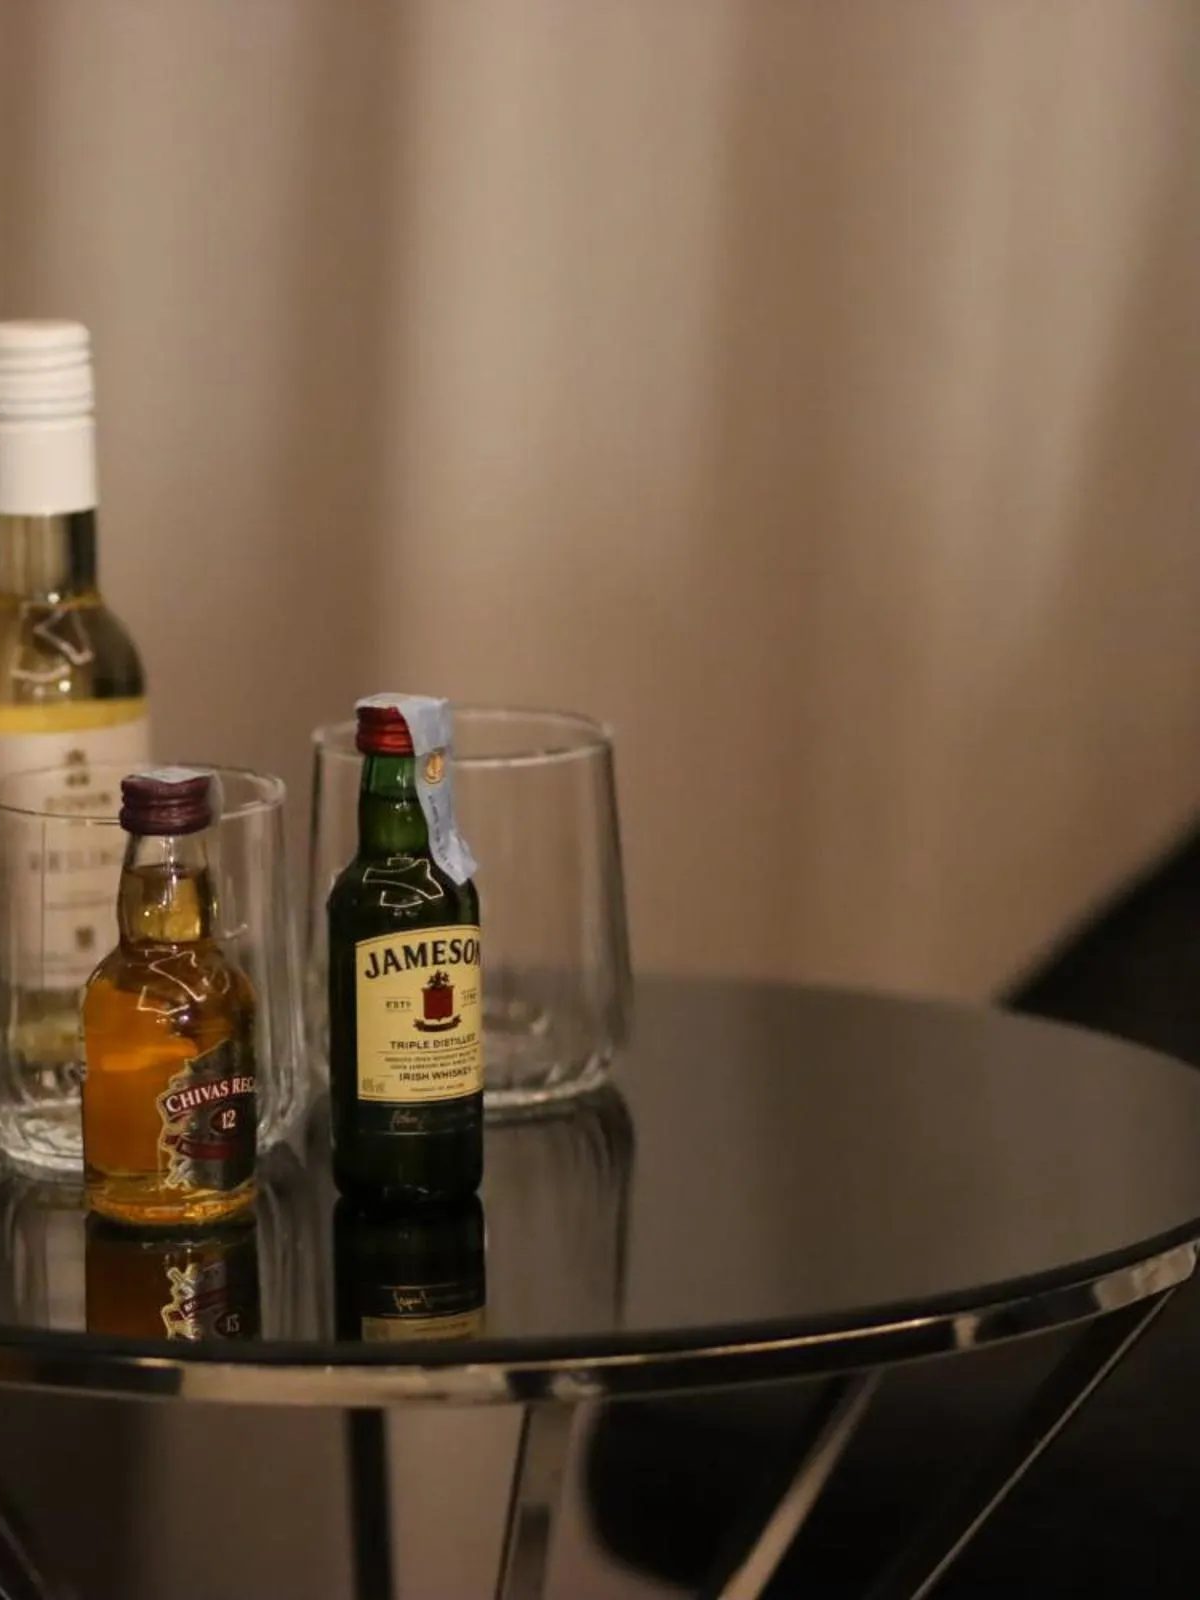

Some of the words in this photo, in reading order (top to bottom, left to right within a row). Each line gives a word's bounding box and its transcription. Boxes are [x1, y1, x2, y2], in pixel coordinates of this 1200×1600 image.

[390, 1040, 430, 1050] TRIPLE
[399, 1071, 430, 1081] IRISH
[165, 1080, 229, 1112] CHIVAS
[231, 1076, 257, 1095] REG
[221, 1108, 237, 1129] 12
